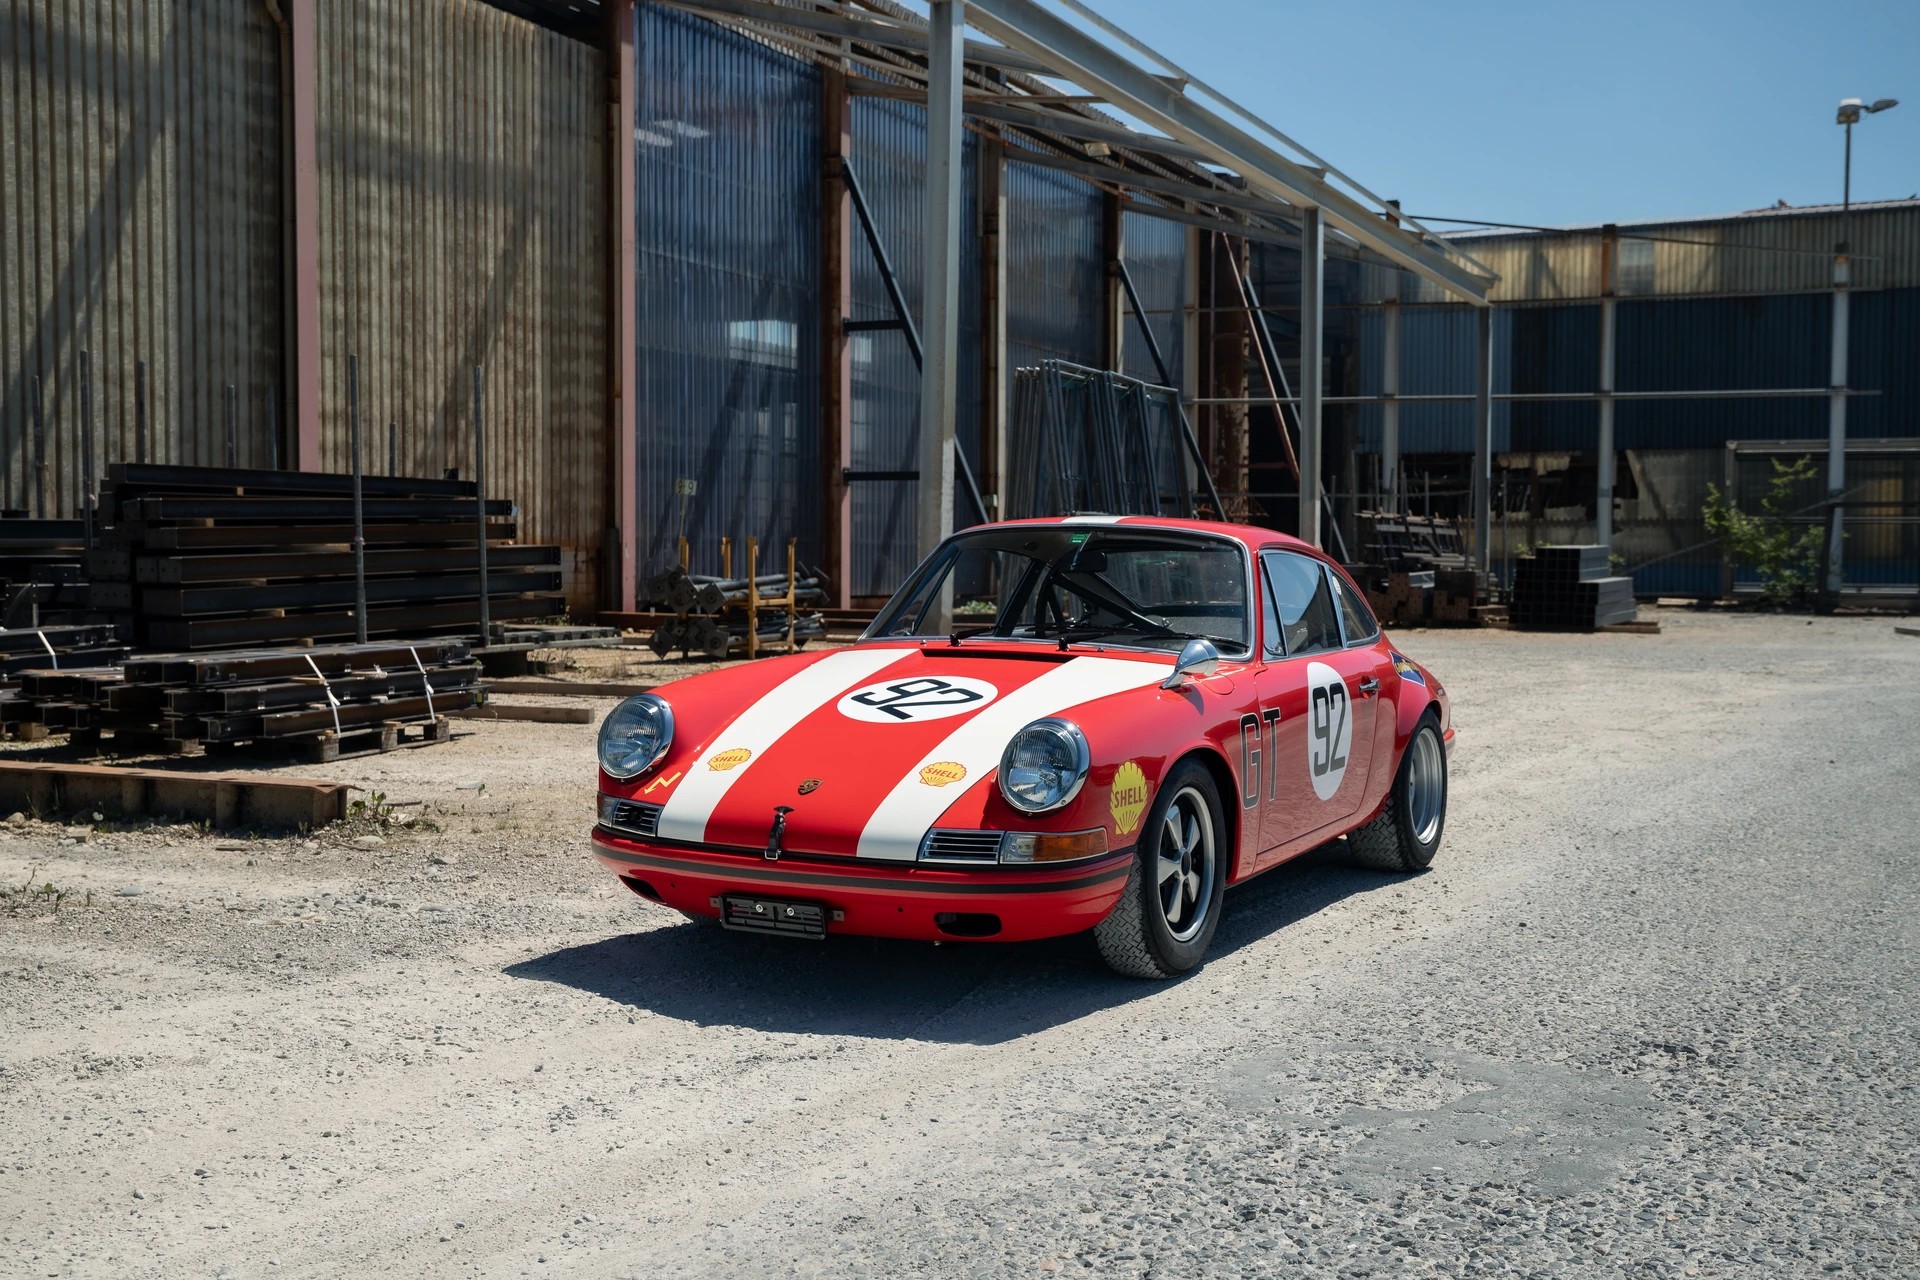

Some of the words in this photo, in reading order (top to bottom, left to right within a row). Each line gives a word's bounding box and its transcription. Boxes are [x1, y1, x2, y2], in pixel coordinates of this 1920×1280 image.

[850, 678, 984, 720] 92
[1312, 682, 1346, 777] 92
[713, 755, 744, 763] SHELL
[925, 767, 958, 780] SHELL
[1240, 706, 1281, 810] GT
[1114, 786, 1144, 809] SHELL
